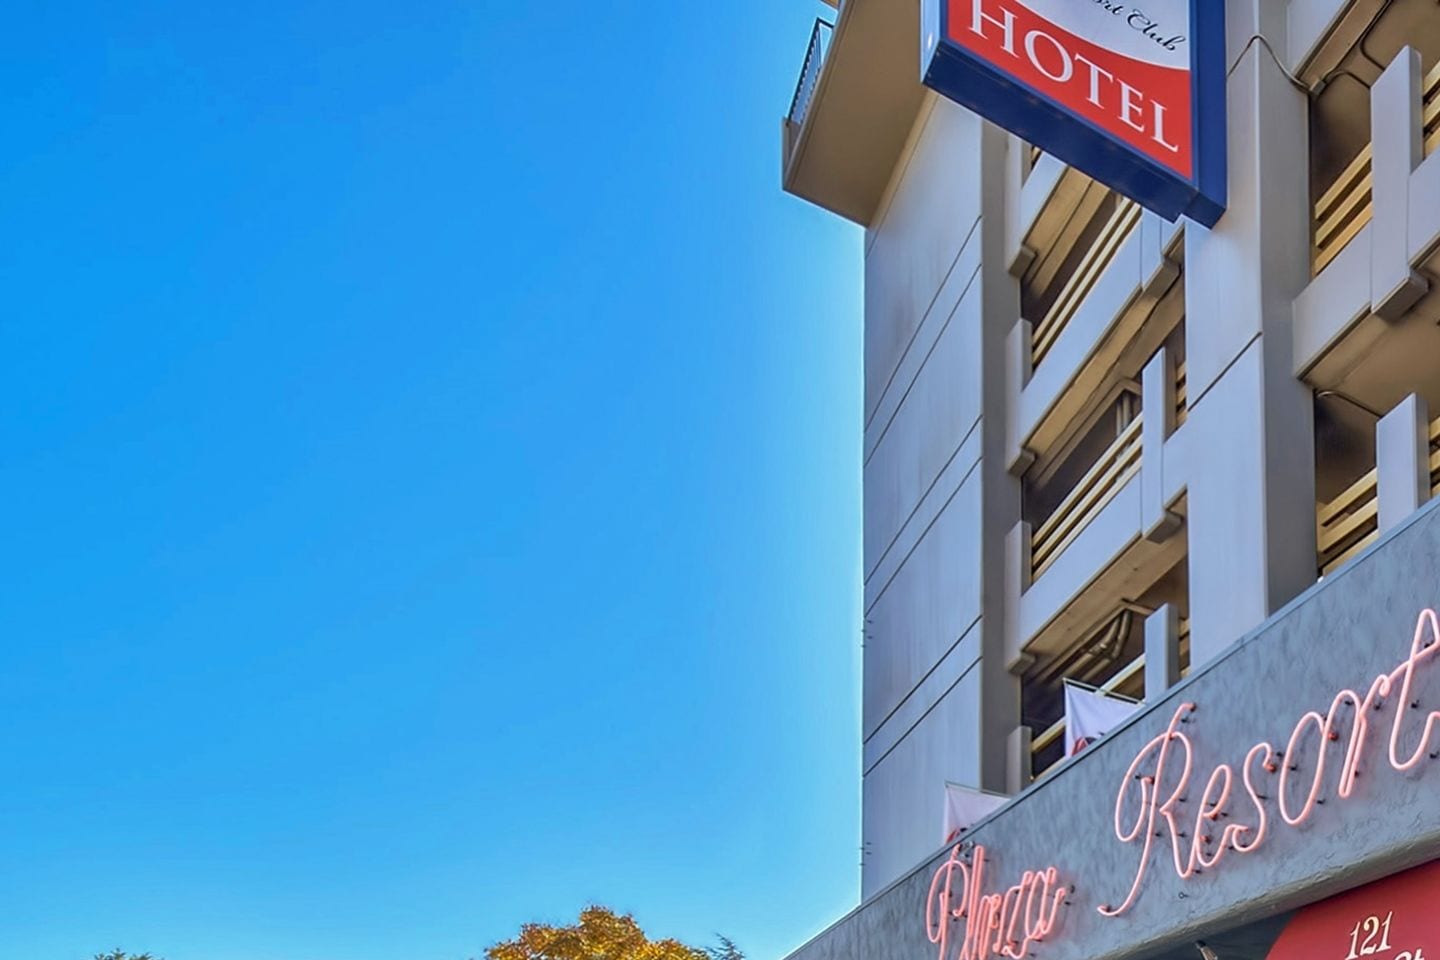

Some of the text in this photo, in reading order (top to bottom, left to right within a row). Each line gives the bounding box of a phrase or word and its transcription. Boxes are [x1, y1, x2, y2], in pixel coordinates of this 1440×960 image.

[1127, 9, 1187, 51] Club
[969, 0, 1179, 153] HOTEL
[1344, 910, 1394, 960] 121
